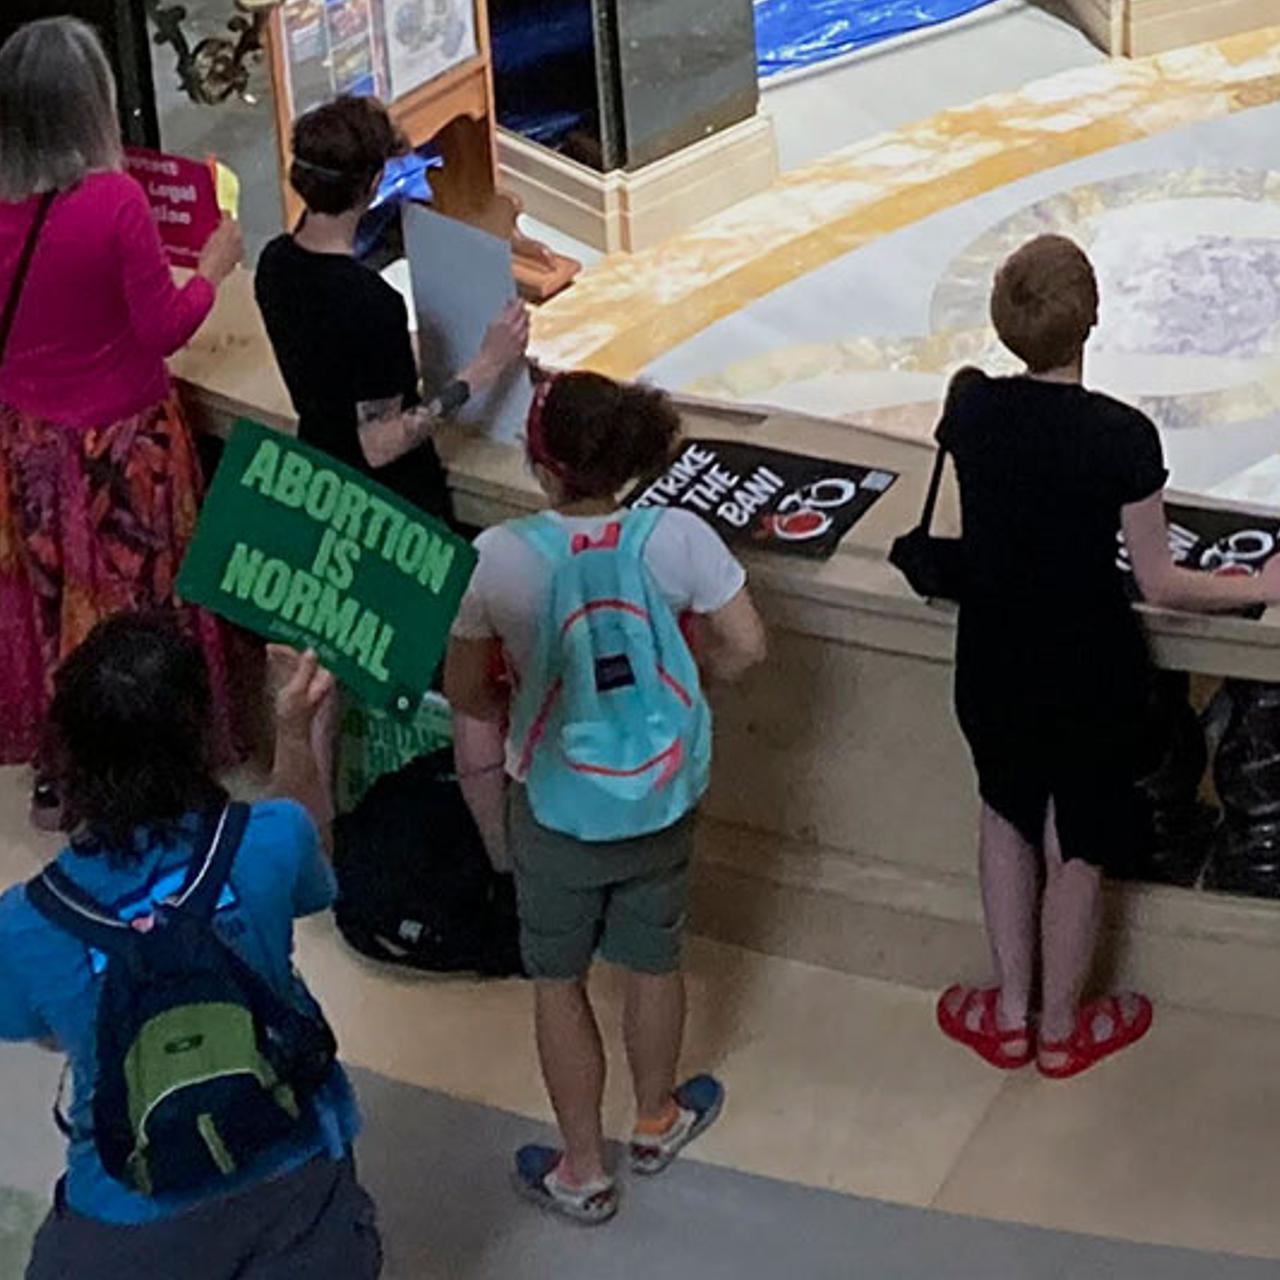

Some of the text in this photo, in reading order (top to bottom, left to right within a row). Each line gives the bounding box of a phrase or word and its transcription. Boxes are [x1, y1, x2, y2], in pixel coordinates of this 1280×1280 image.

[240, 438, 456, 595] ABORTION
[679, 462, 741, 511] THE
[311, 528, 361, 590] IS
[220, 542, 396, 684] NORMAL
